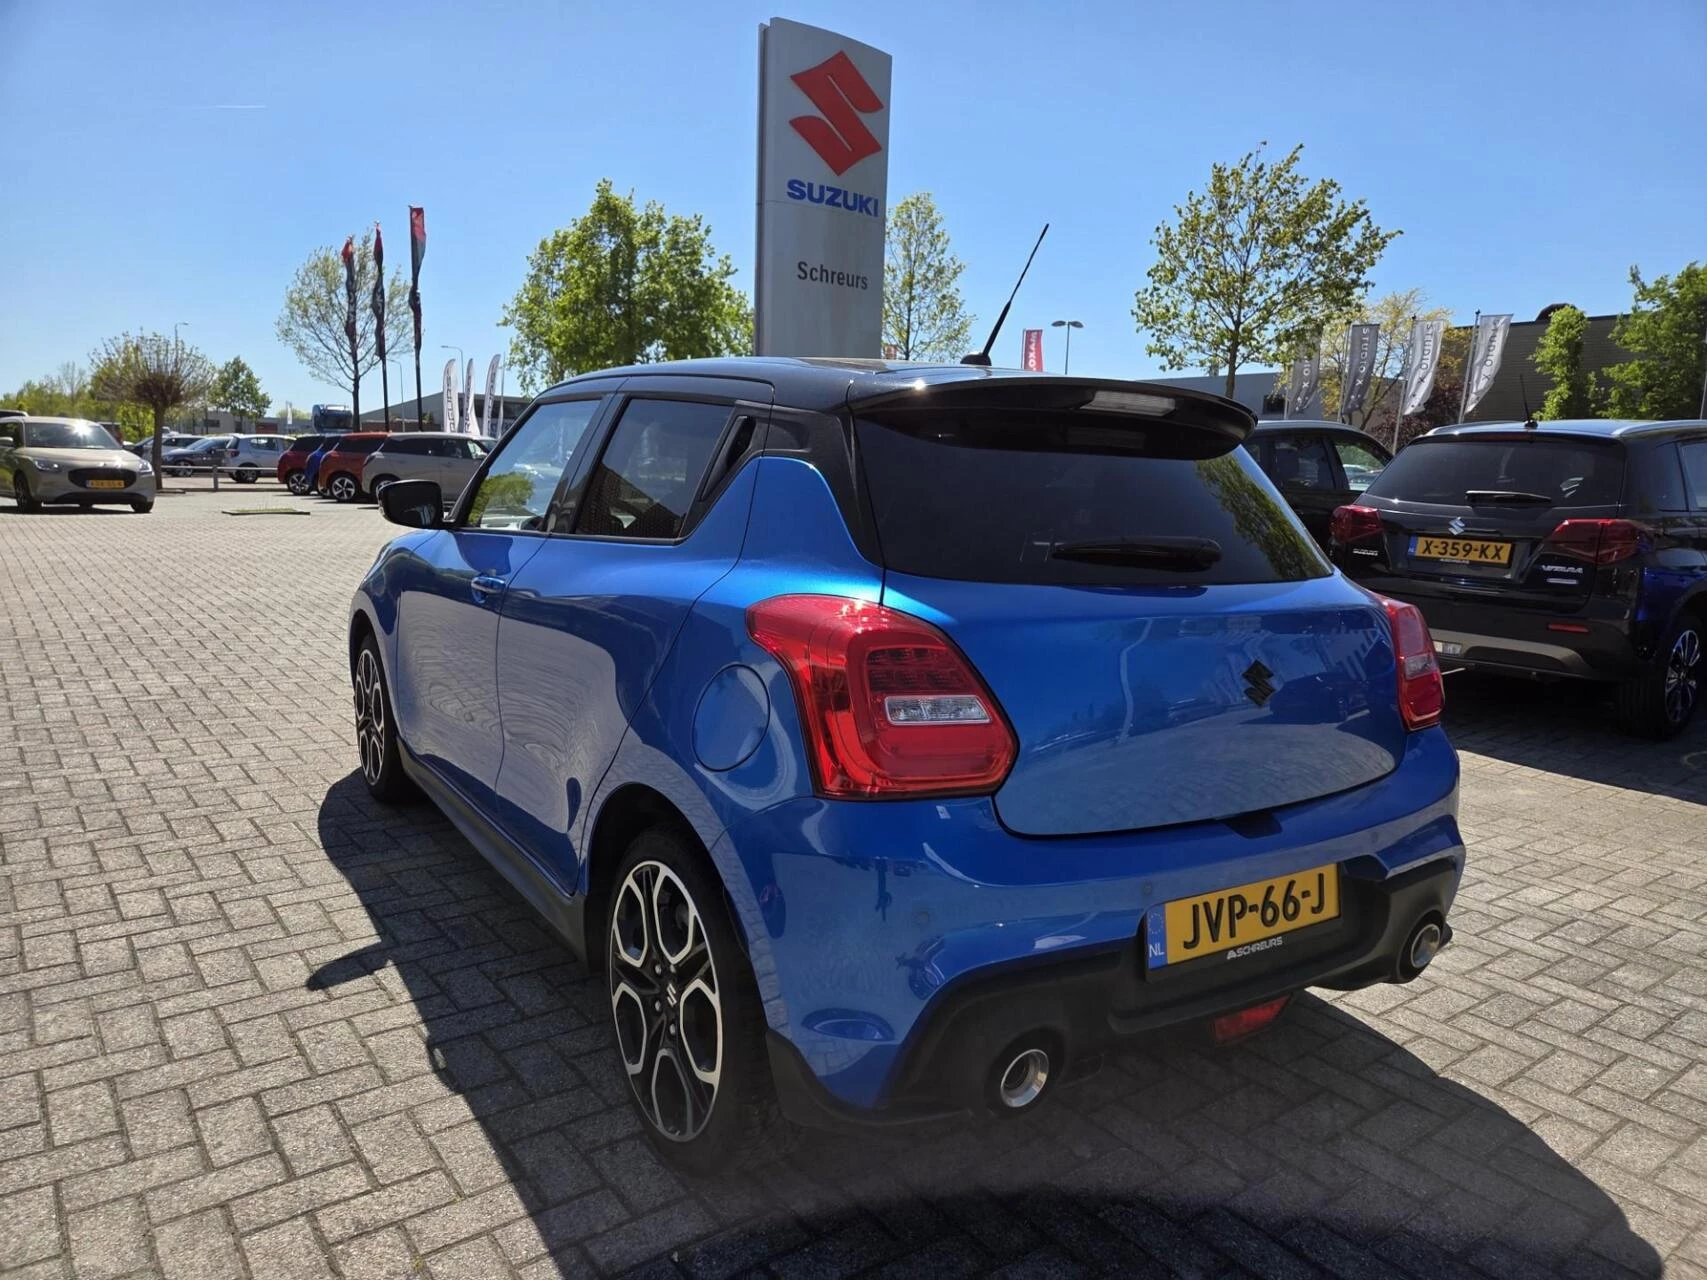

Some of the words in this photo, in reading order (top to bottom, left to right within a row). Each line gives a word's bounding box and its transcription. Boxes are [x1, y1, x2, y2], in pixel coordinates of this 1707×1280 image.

[787, 179, 878, 217] SUZUKI
[797, 261, 868, 290] Schreurs
[1029, 331, 1037, 370] OXAM
[1360, 327, 1369, 373] STUDIO
[1420, 323, 1433, 370] STUDIO
[1484, 319, 1498, 367] STUDIO
[1481, 373, 1491, 381] X
[1422, 540, 1504, 560] X-359-KX
[1183, 873, 1324, 950] JVP-66-J
[1149, 944, 1164, 958] NL
